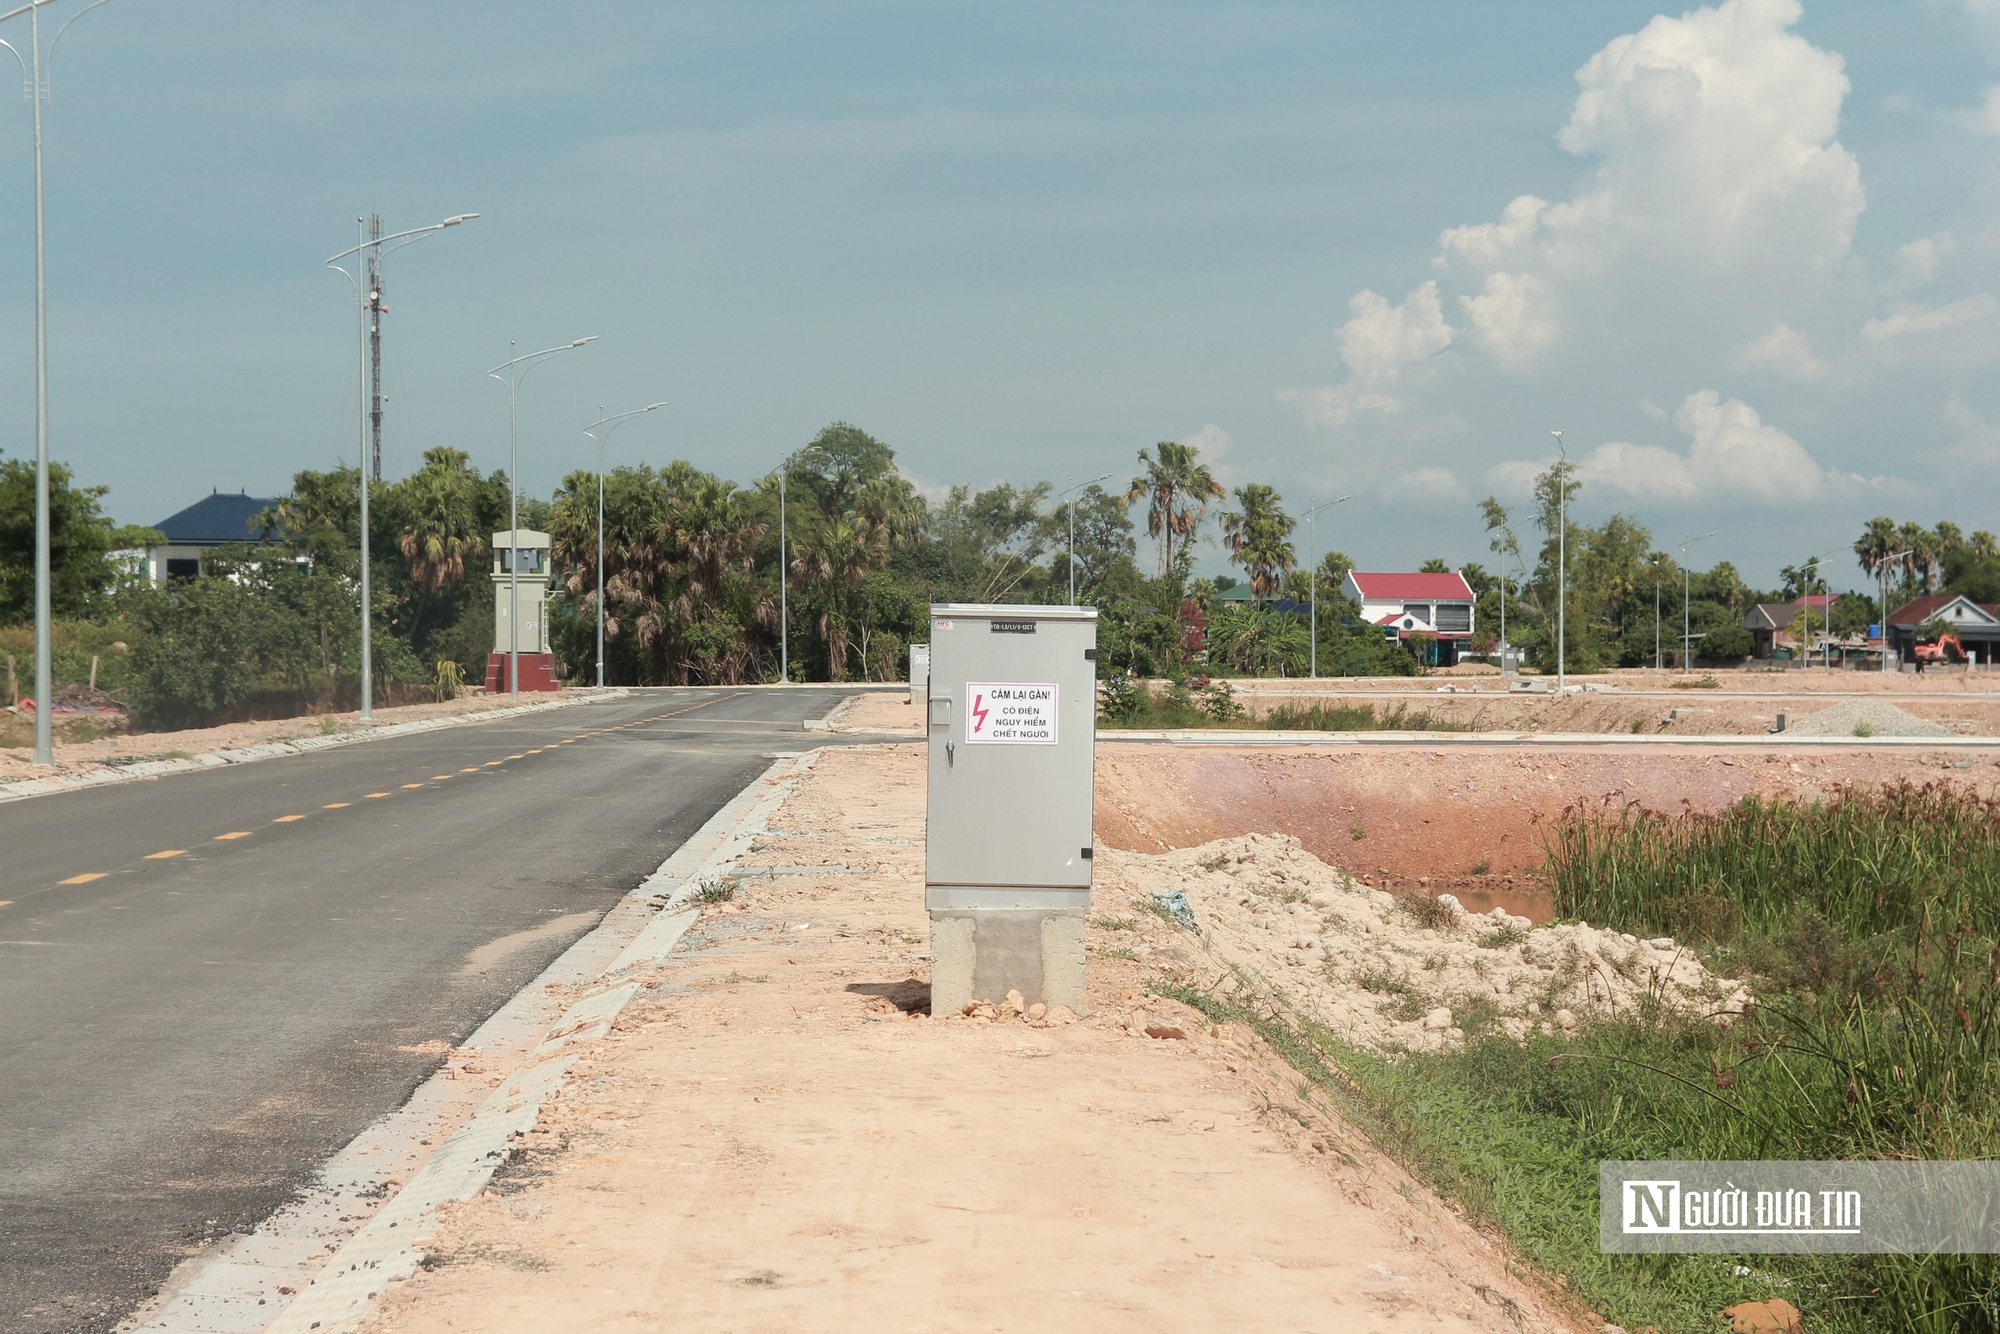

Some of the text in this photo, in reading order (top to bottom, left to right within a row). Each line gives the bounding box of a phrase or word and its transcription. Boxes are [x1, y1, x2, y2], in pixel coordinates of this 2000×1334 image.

[991, 688, 1050, 701] CẤM LẠI GẦN!
[1002, 705, 1039, 715] CÓ ĐIỆN
[996, 716, 1046, 726] NGUY HIỂM
[993, 728, 1048, 738] CHẾT NGƯỜI
